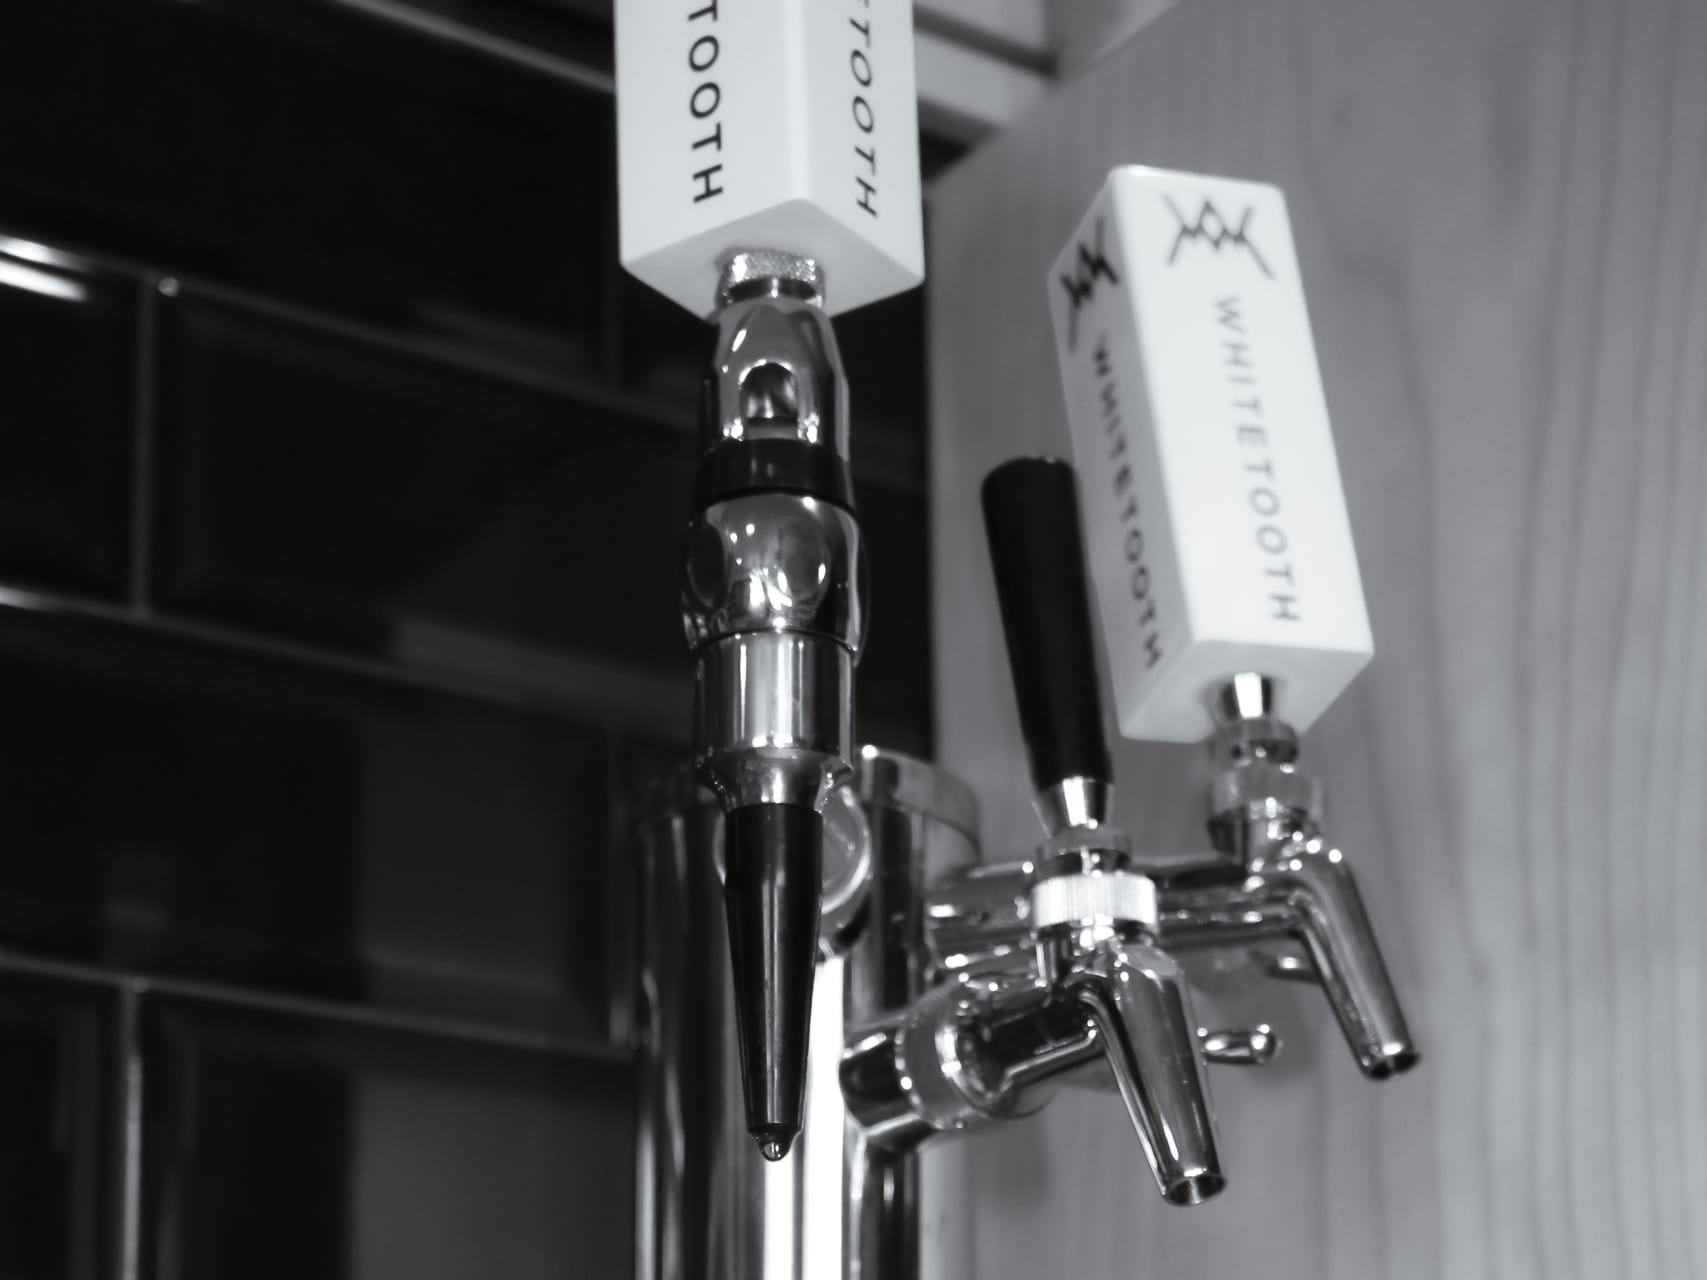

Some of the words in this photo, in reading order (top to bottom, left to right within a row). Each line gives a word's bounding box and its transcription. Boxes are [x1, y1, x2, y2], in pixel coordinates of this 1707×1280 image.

[848, 0, 878, 217] TOOTH
[1093, 335, 1162, 669] WHITETOOTH
[1212, 296, 1301, 622] WHITETOOTH
